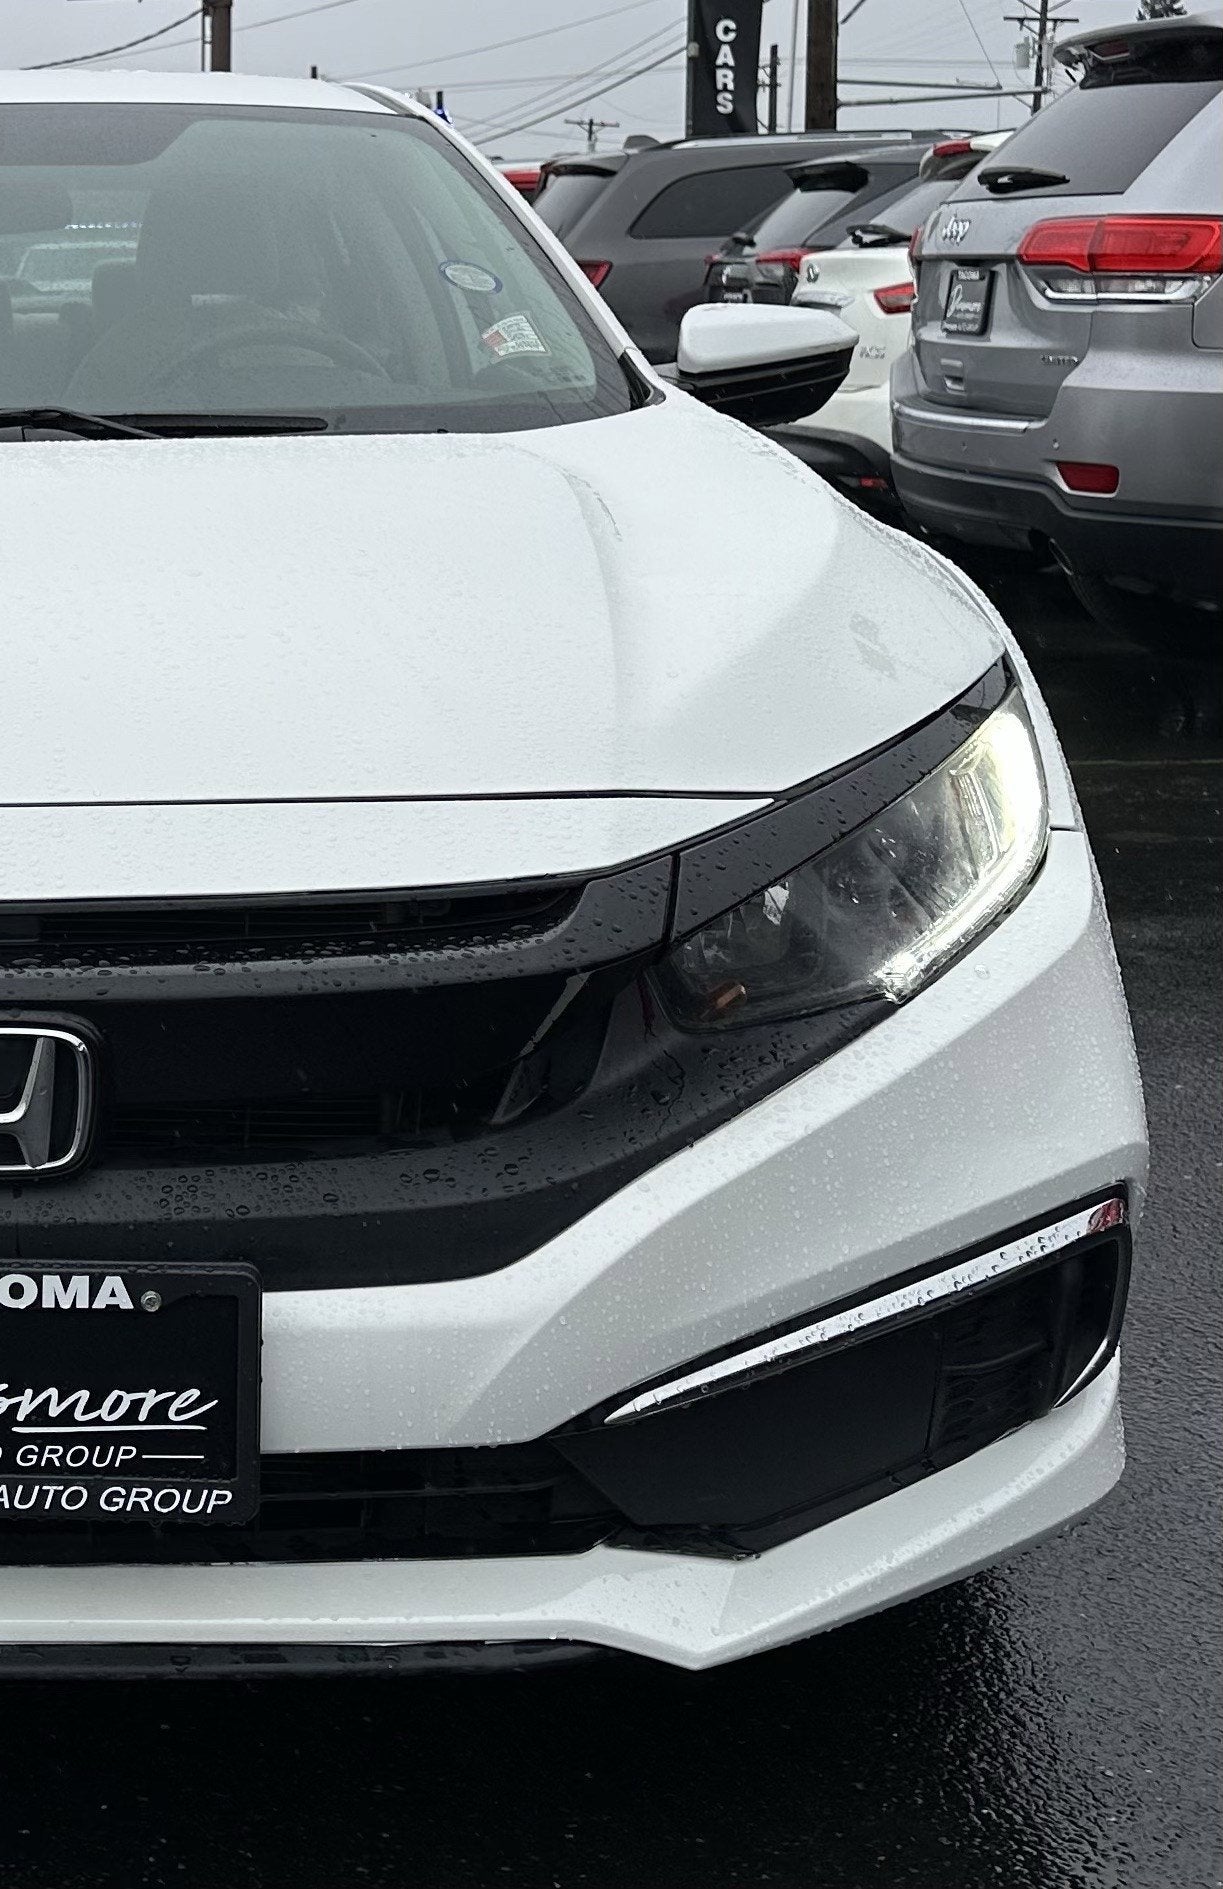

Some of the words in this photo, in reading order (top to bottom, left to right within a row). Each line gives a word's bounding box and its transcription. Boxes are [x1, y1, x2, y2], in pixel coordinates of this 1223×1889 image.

[715, 18, 737, 115] CARS
[15, 1444, 137, 1468] GROUP
[99, 1486, 233, 1514] GROUP
